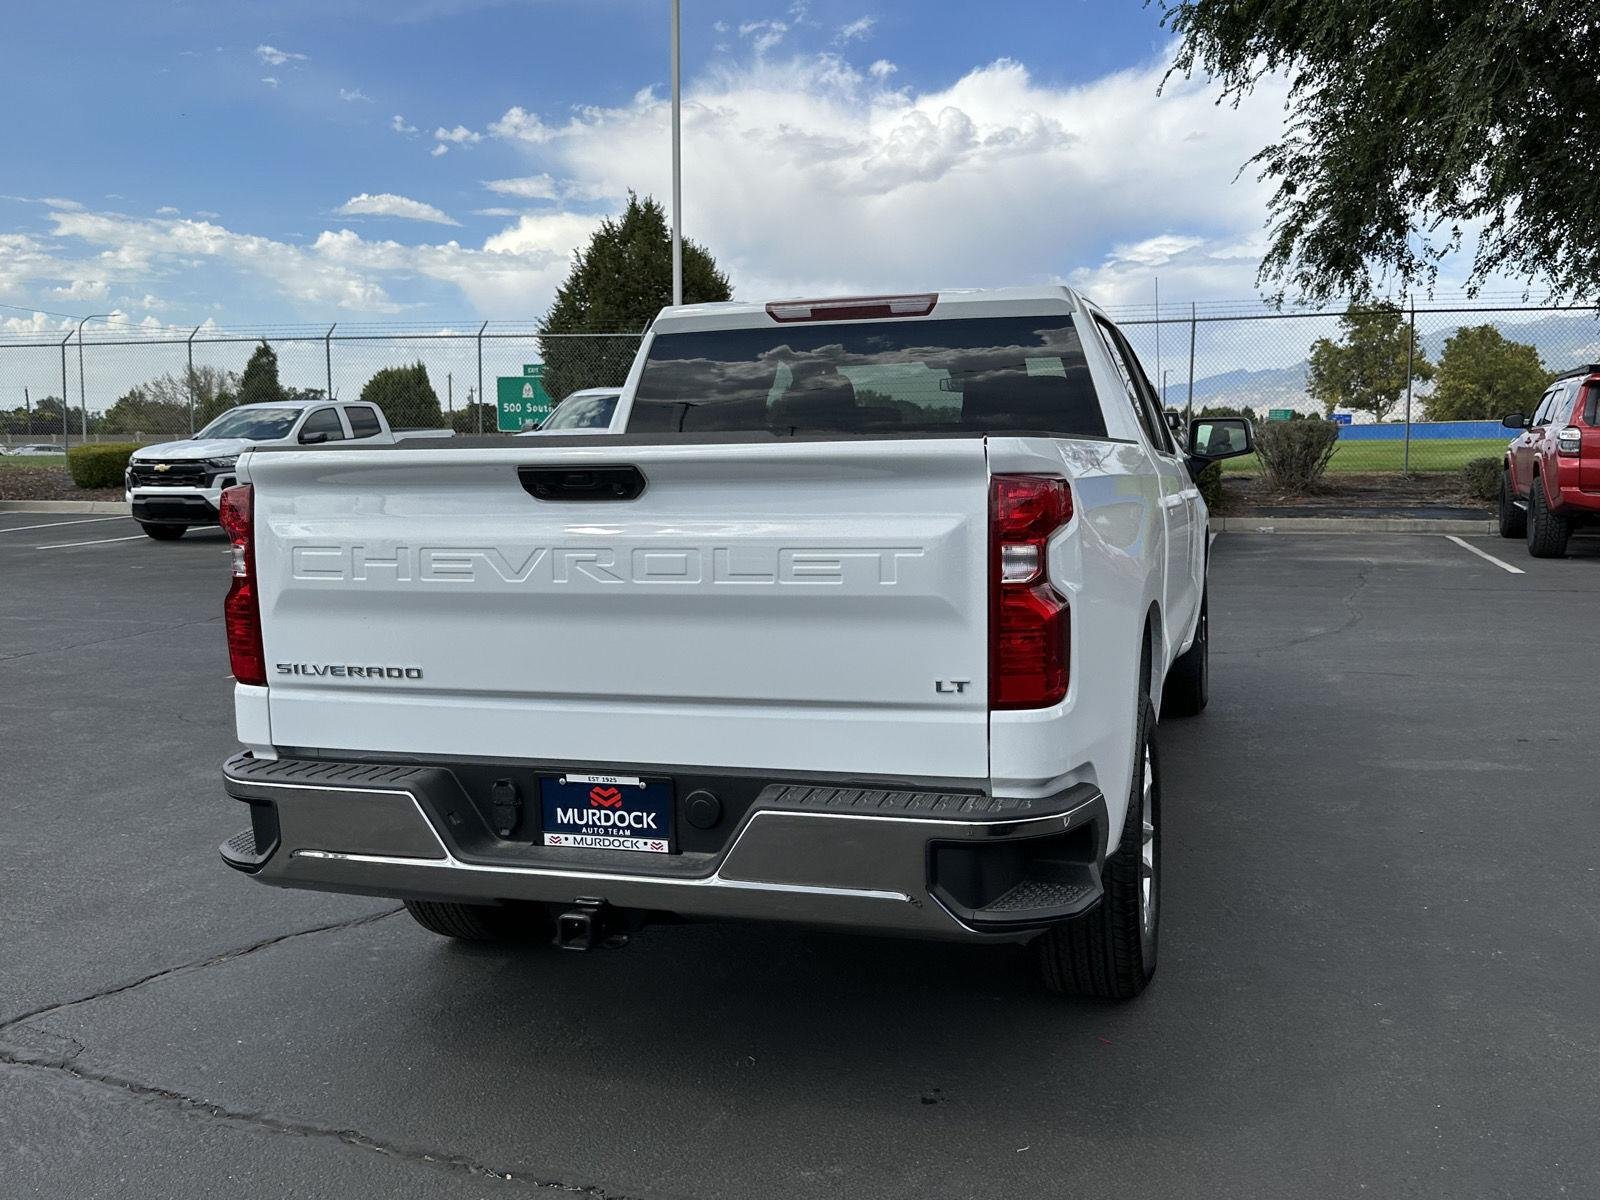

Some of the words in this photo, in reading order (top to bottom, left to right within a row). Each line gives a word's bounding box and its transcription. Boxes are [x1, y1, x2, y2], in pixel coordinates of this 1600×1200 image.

[503, 403, 521, 412] 500
[518, 417, 522, 425] 1
[291, 545, 925, 586] CHEVROLET
[276, 663, 424, 679] SILVERADO
[935, 680, 971, 693] LT
[556, 807, 658, 829] MURDOCK
[608, 828, 631, 836] TEAM
[573, 837, 640, 849] MURDOCK
